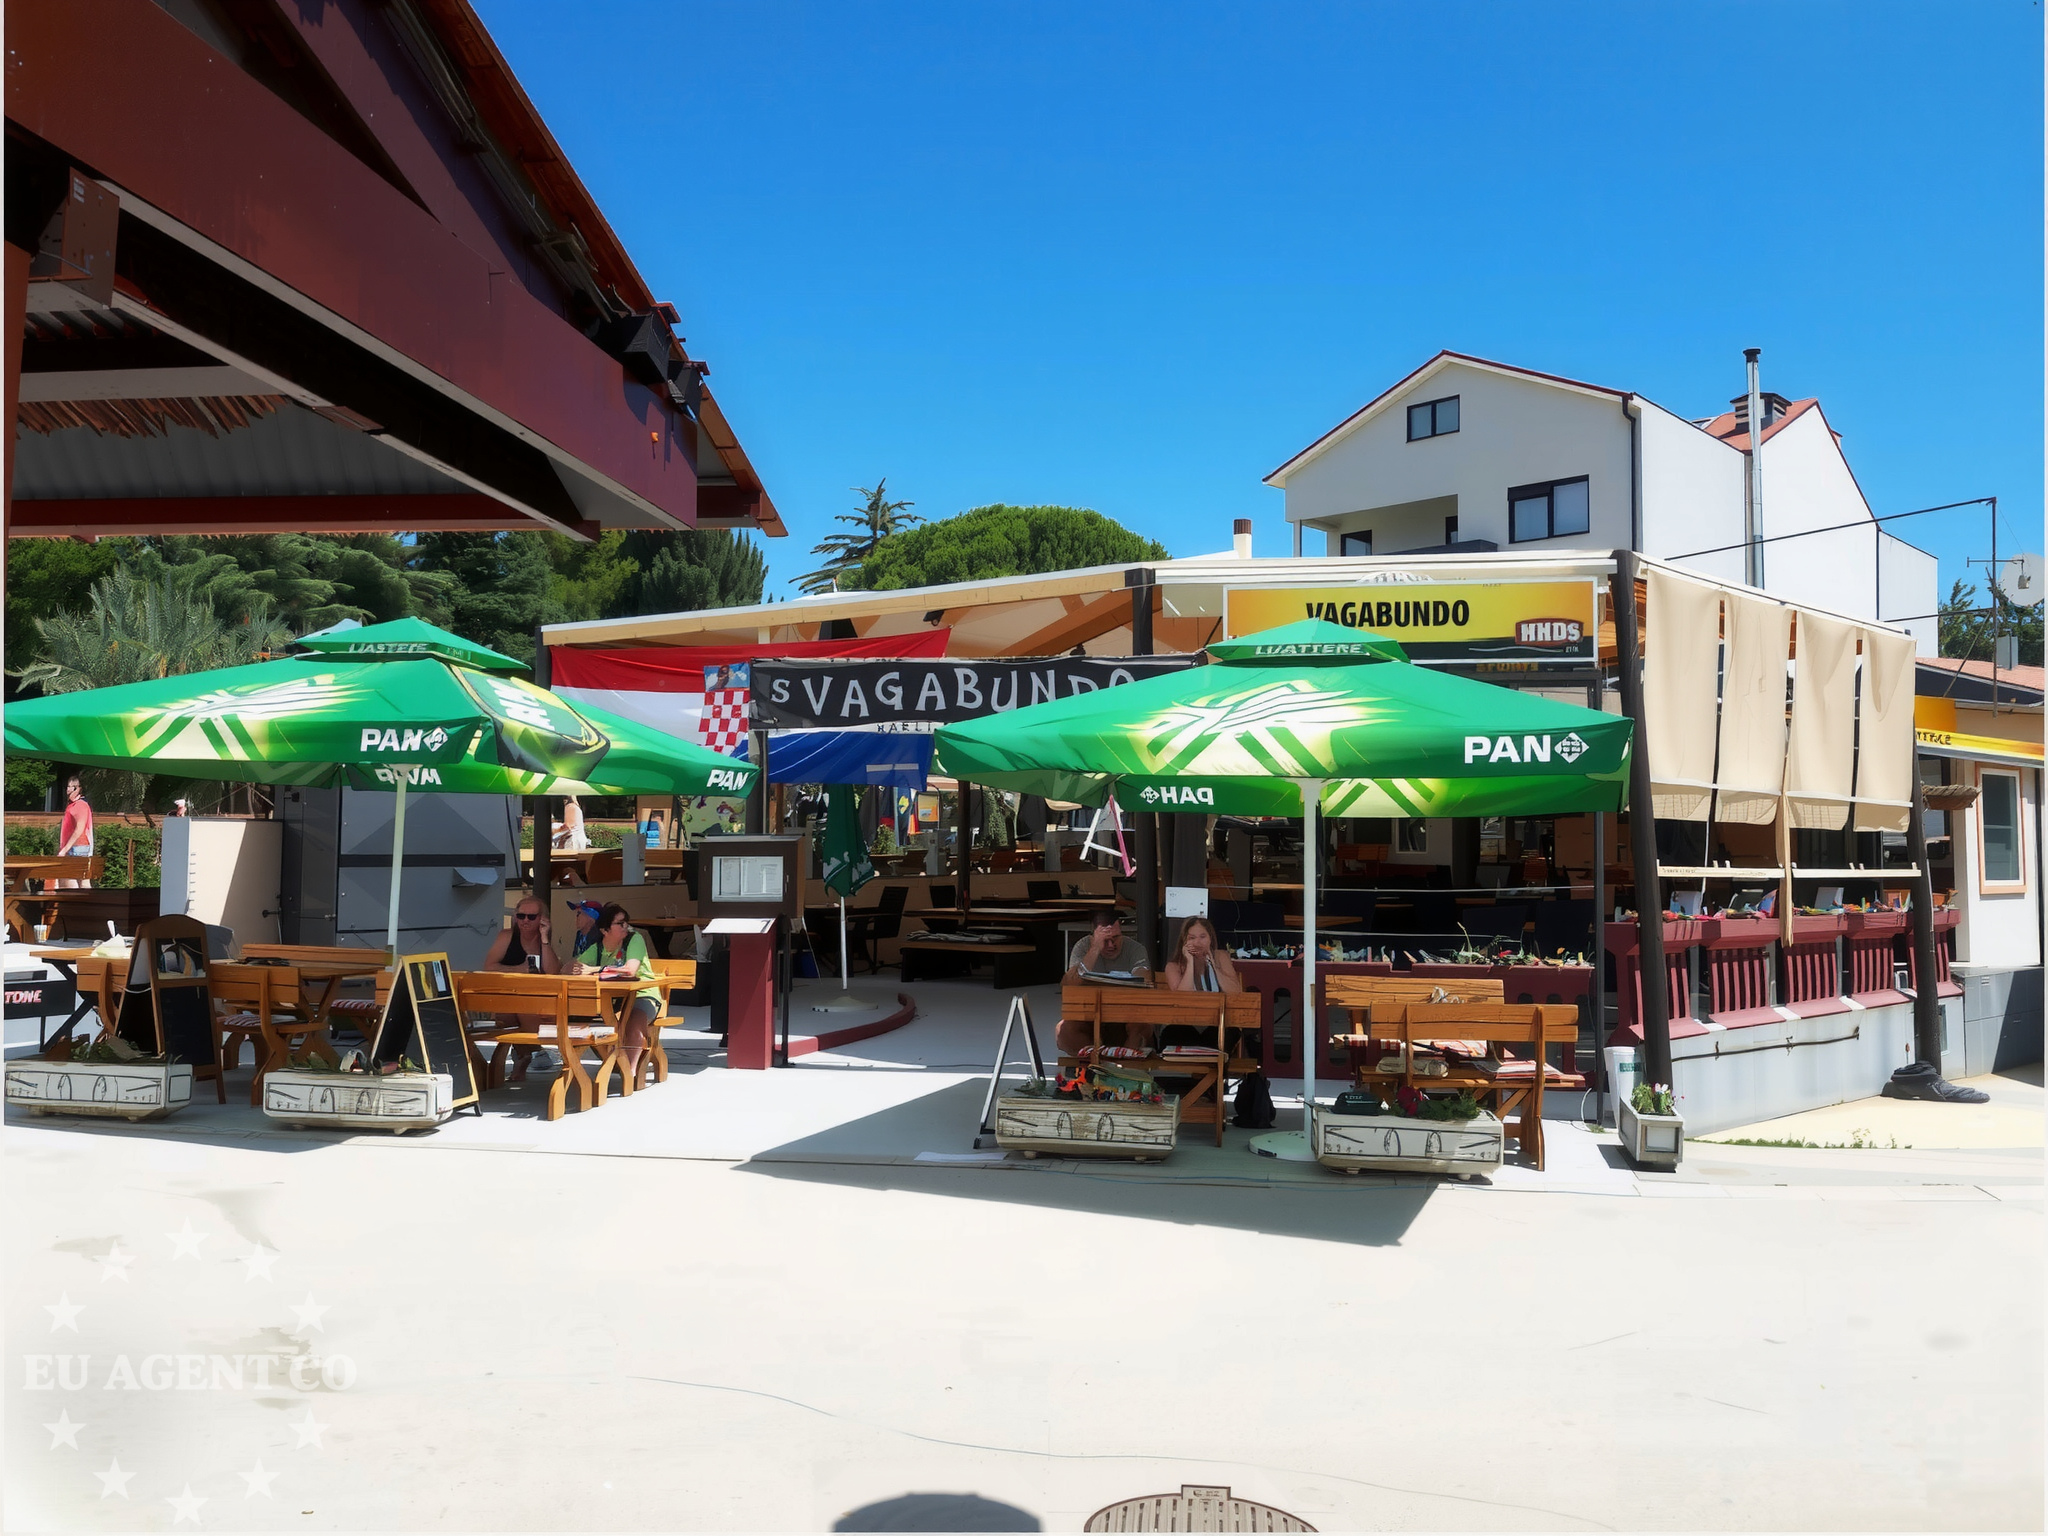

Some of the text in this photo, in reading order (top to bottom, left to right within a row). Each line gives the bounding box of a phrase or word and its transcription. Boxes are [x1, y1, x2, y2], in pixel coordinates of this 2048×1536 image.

[1305, 600, 1470, 628] VAGABUNDO
[360, 728, 424, 752] PAN
[1464, 734, 1551, 764] PAN
[706, 769, 749, 791] PAN
